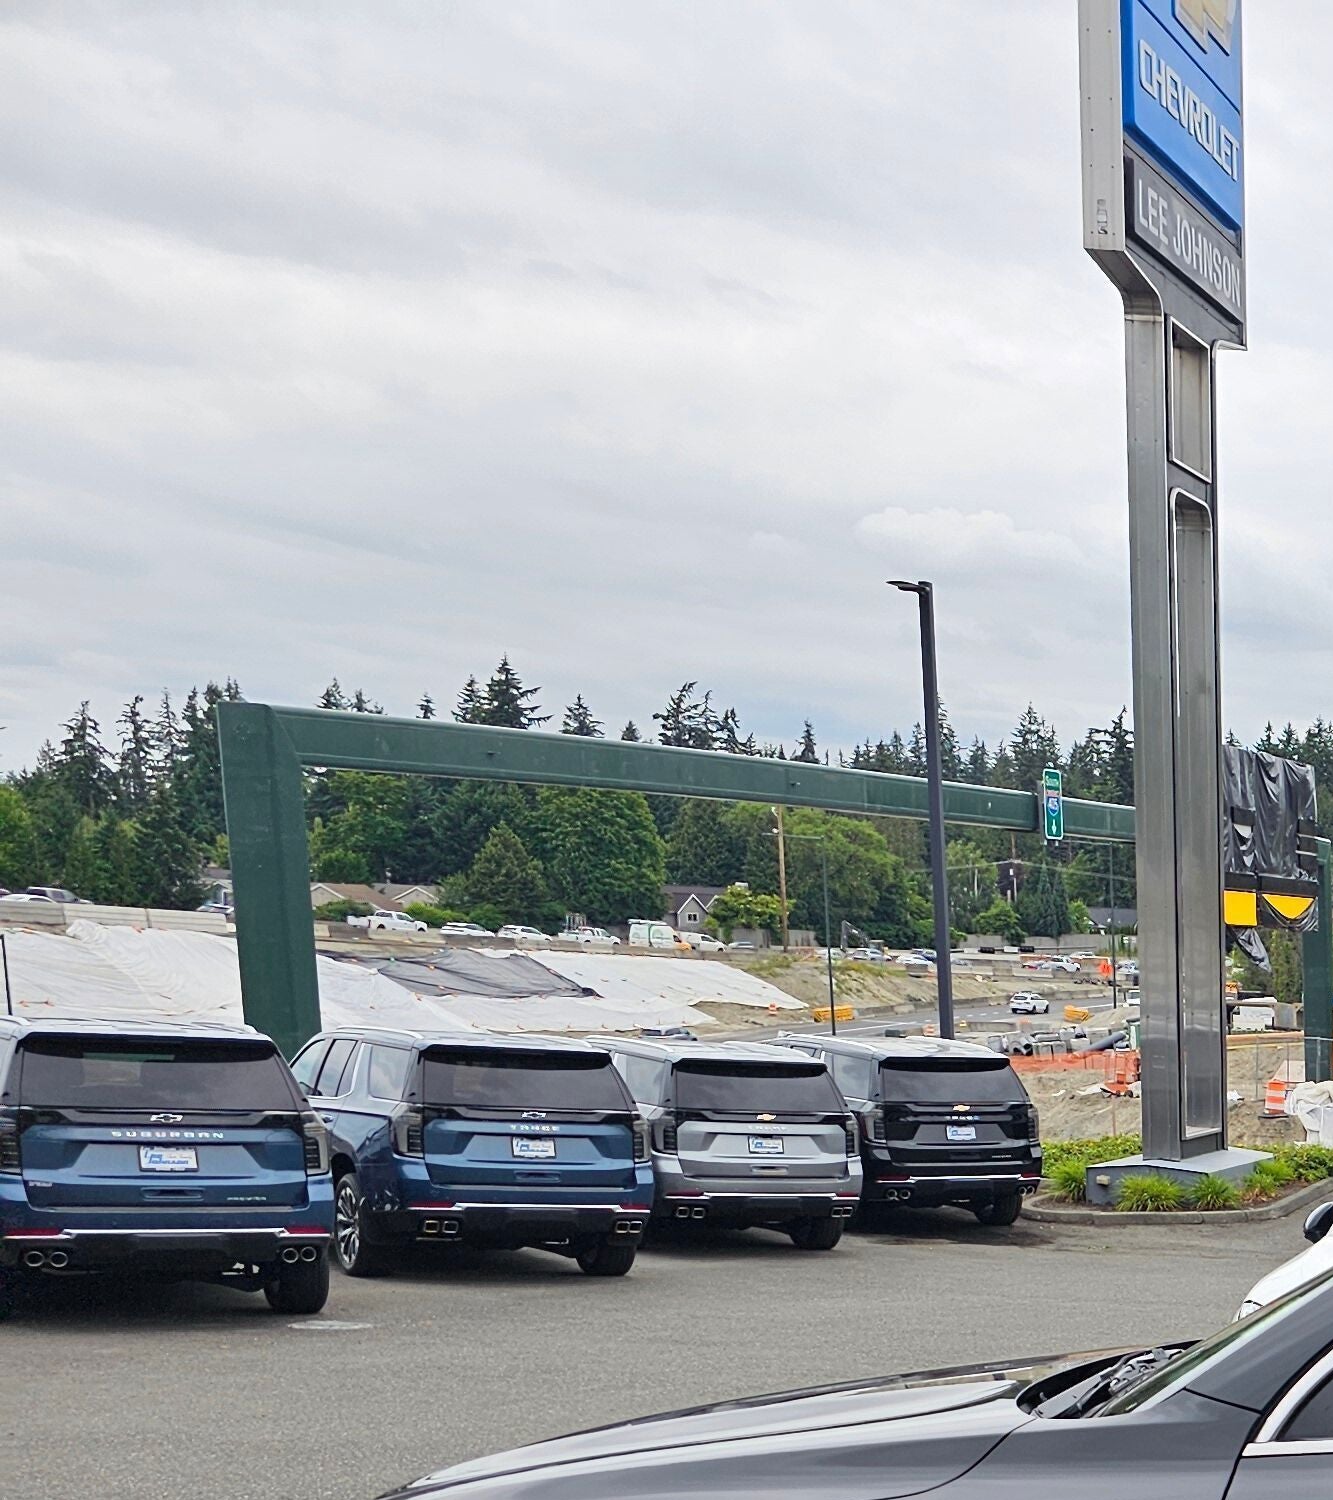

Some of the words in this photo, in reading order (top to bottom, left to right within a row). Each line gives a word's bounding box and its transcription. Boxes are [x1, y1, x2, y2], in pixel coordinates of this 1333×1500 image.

[1138, 39, 1240, 182] CHEVROLET
[1137, 178, 1169, 246] LEE
[1172, 212, 1241, 308] JOHNSON
[111, 1131, 224, 1140] SUBURBAN
